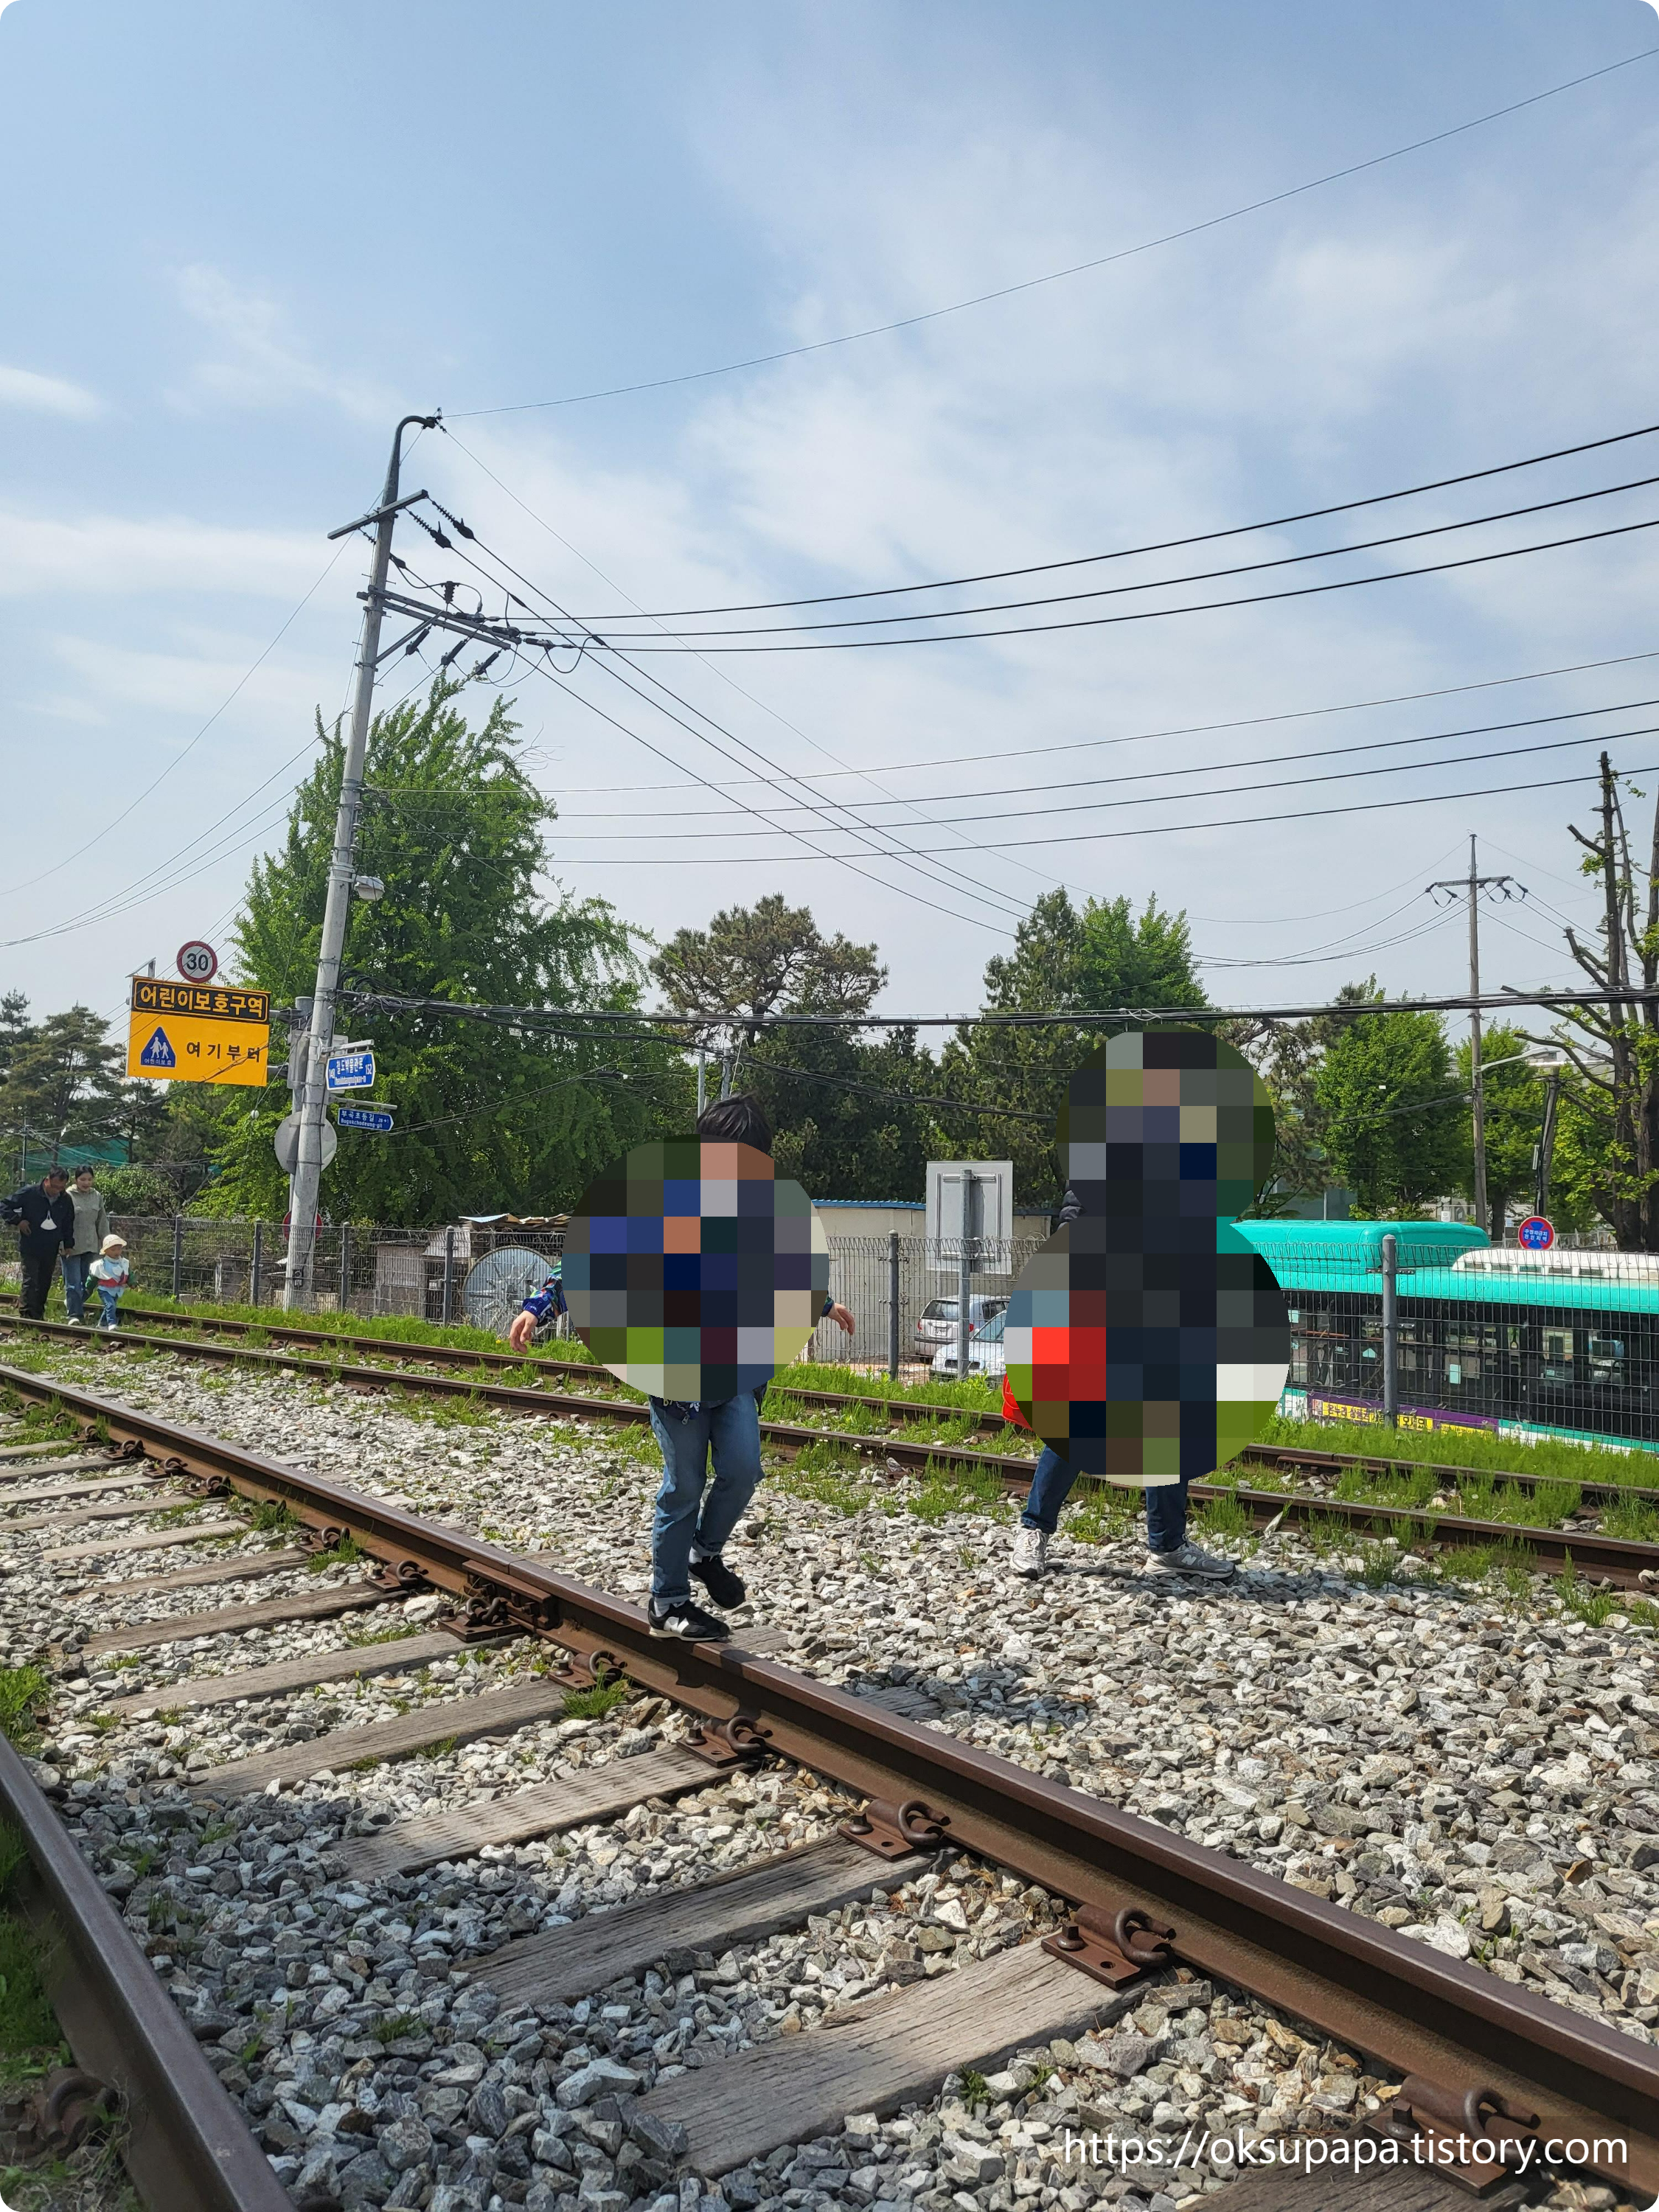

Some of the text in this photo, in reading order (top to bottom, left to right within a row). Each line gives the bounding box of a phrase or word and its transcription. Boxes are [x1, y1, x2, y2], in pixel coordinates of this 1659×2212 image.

[186, 953, 209, 971] 30
[140, 986, 262, 1018] 어린이보호구역
[341, 1110, 375, 1122] 부곡초등길
[1181, 1554, 1197, 1565] N
